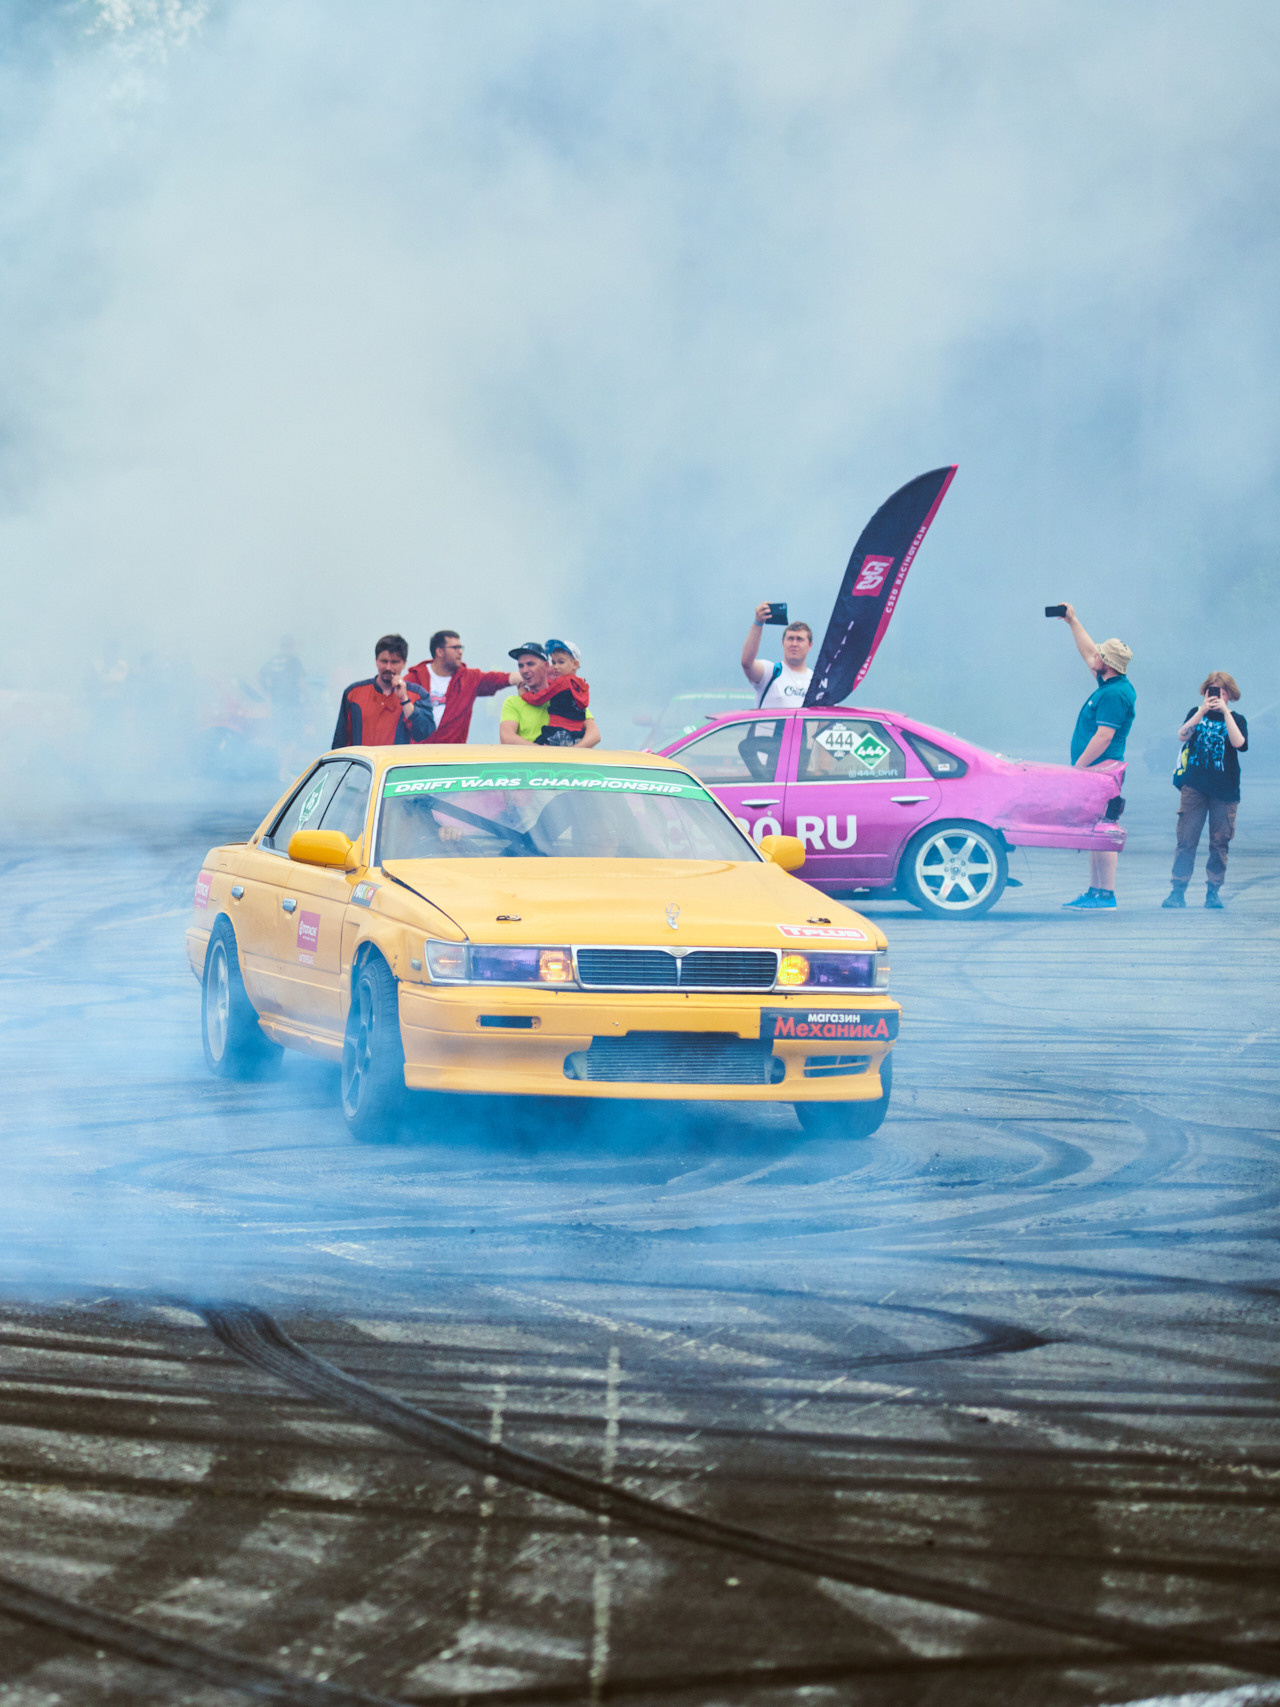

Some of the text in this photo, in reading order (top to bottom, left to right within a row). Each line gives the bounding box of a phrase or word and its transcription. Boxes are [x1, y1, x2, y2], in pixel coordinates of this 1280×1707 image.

[825, 732, 854, 748] 444
[393, 777, 684, 794] DRIFT WARS CHAMPIONSHIP
[807, 1013, 861, 1024] магазин
